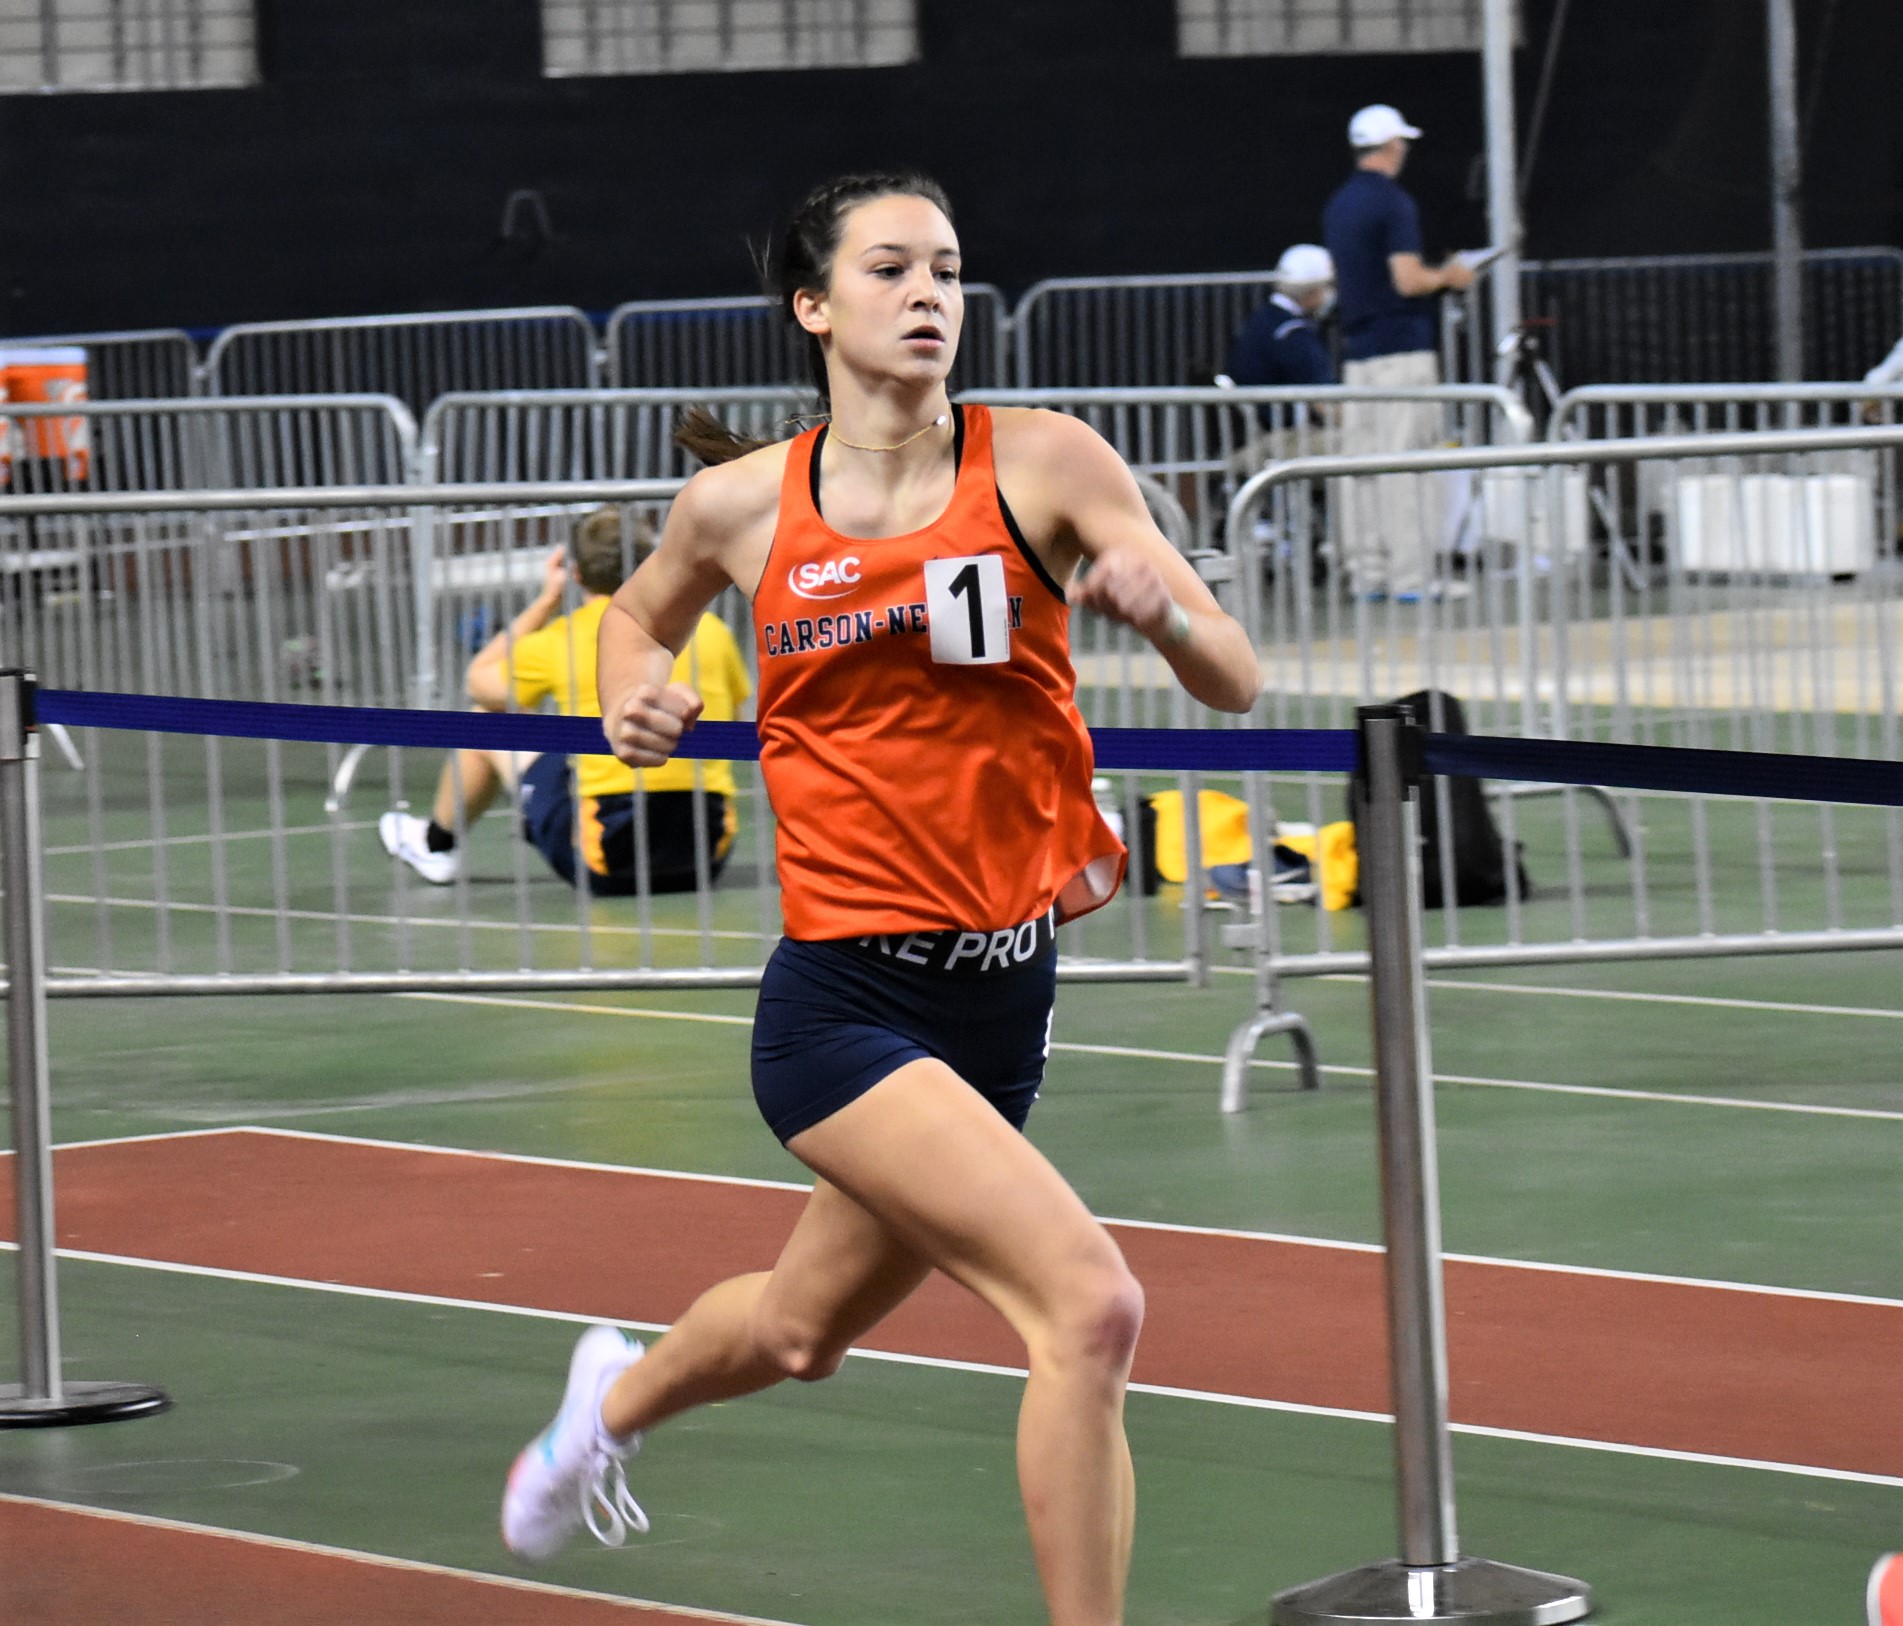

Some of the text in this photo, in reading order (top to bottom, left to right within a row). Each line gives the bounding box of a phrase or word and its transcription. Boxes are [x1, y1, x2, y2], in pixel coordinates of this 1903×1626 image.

[800, 557, 862, 589] SAC
[764, 595, 1024, 658] CARSON-NEN
[948, 563, 986, 659] 1
[944, 919, 1037, 972] PRO
